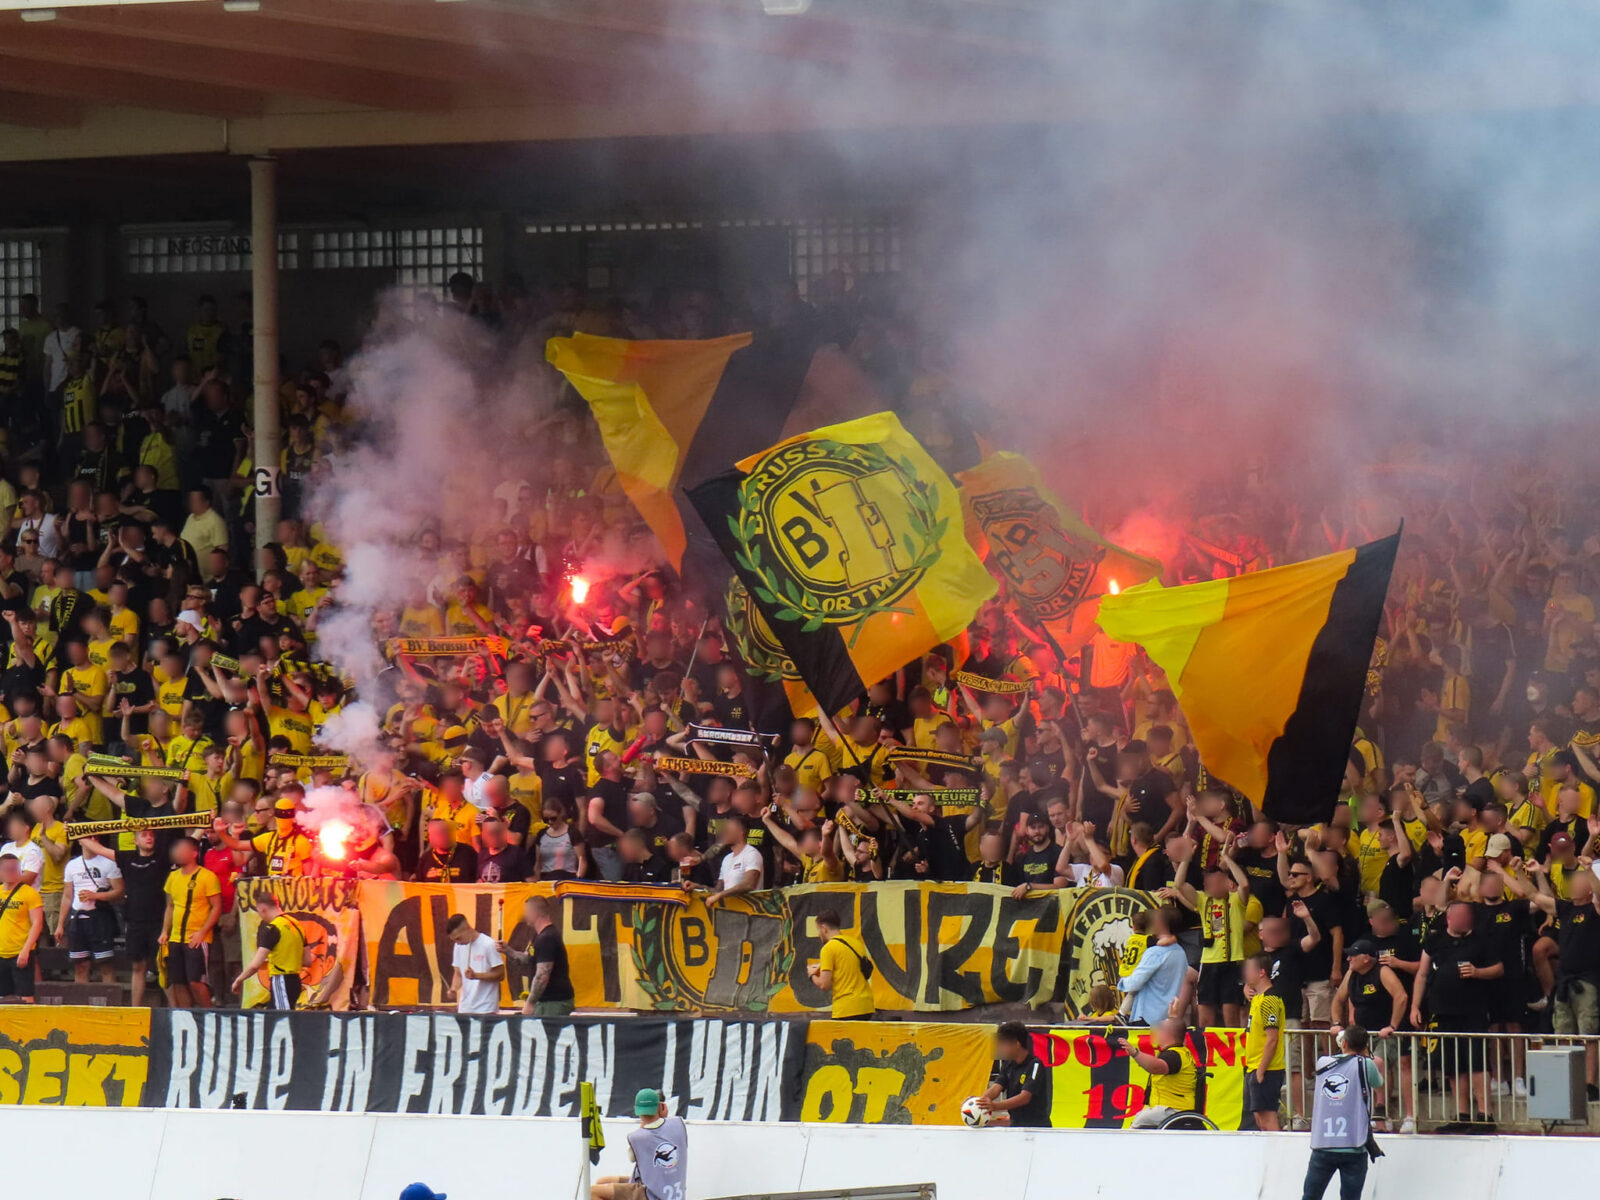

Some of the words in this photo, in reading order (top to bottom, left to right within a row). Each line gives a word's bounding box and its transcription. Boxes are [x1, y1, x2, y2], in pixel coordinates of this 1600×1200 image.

[68, 823, 122, 837] BORUSSIA
[151, 813, 211, 827] DORTMUND
[1323, 1116, 1347, 1137] 12
[662, 1180, 684, 1200] 23
